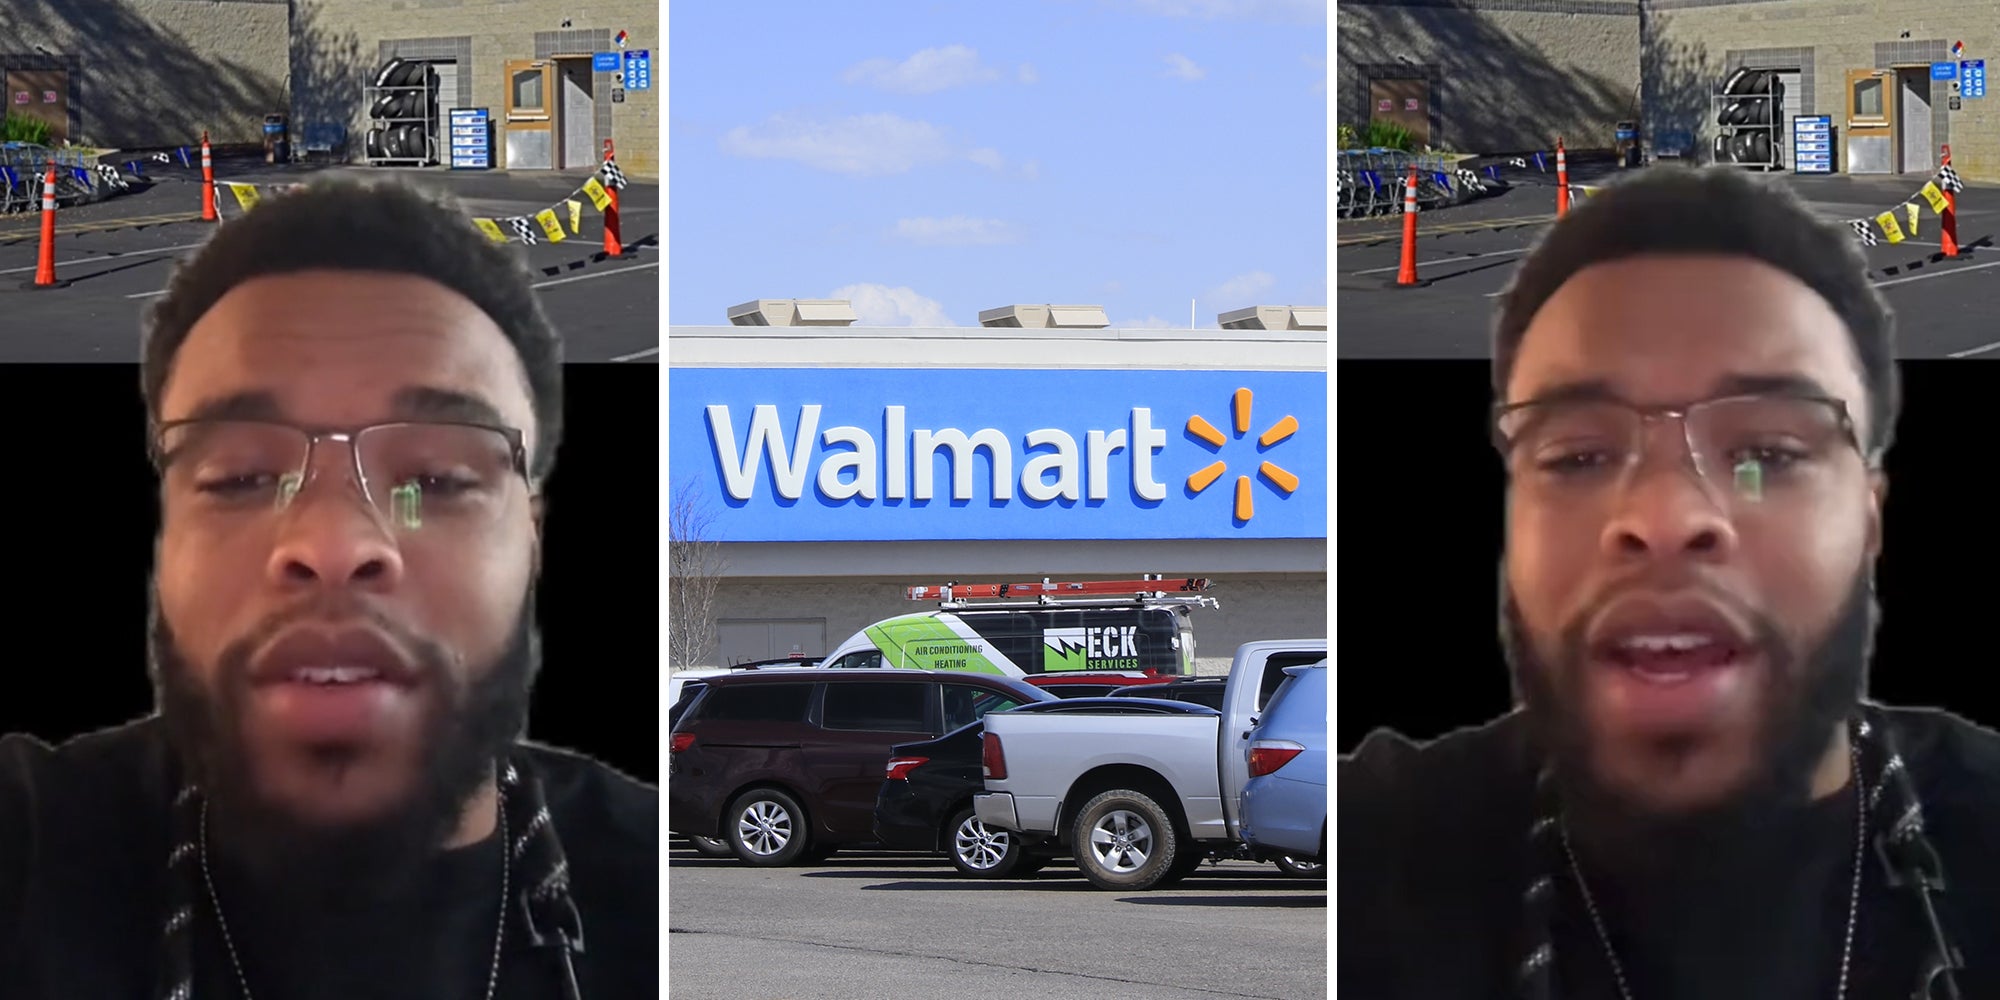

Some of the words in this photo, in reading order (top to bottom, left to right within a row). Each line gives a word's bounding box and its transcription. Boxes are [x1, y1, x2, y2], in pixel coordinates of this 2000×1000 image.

[706, 404, 1166, 501] Walmart
[915, 647, 928, 656] AIR
[929, 645, 983, 655] CONDITIONING
[934, 659, 966, 669] HEATING
[1088, 659, 1138, 670] SERVICES
